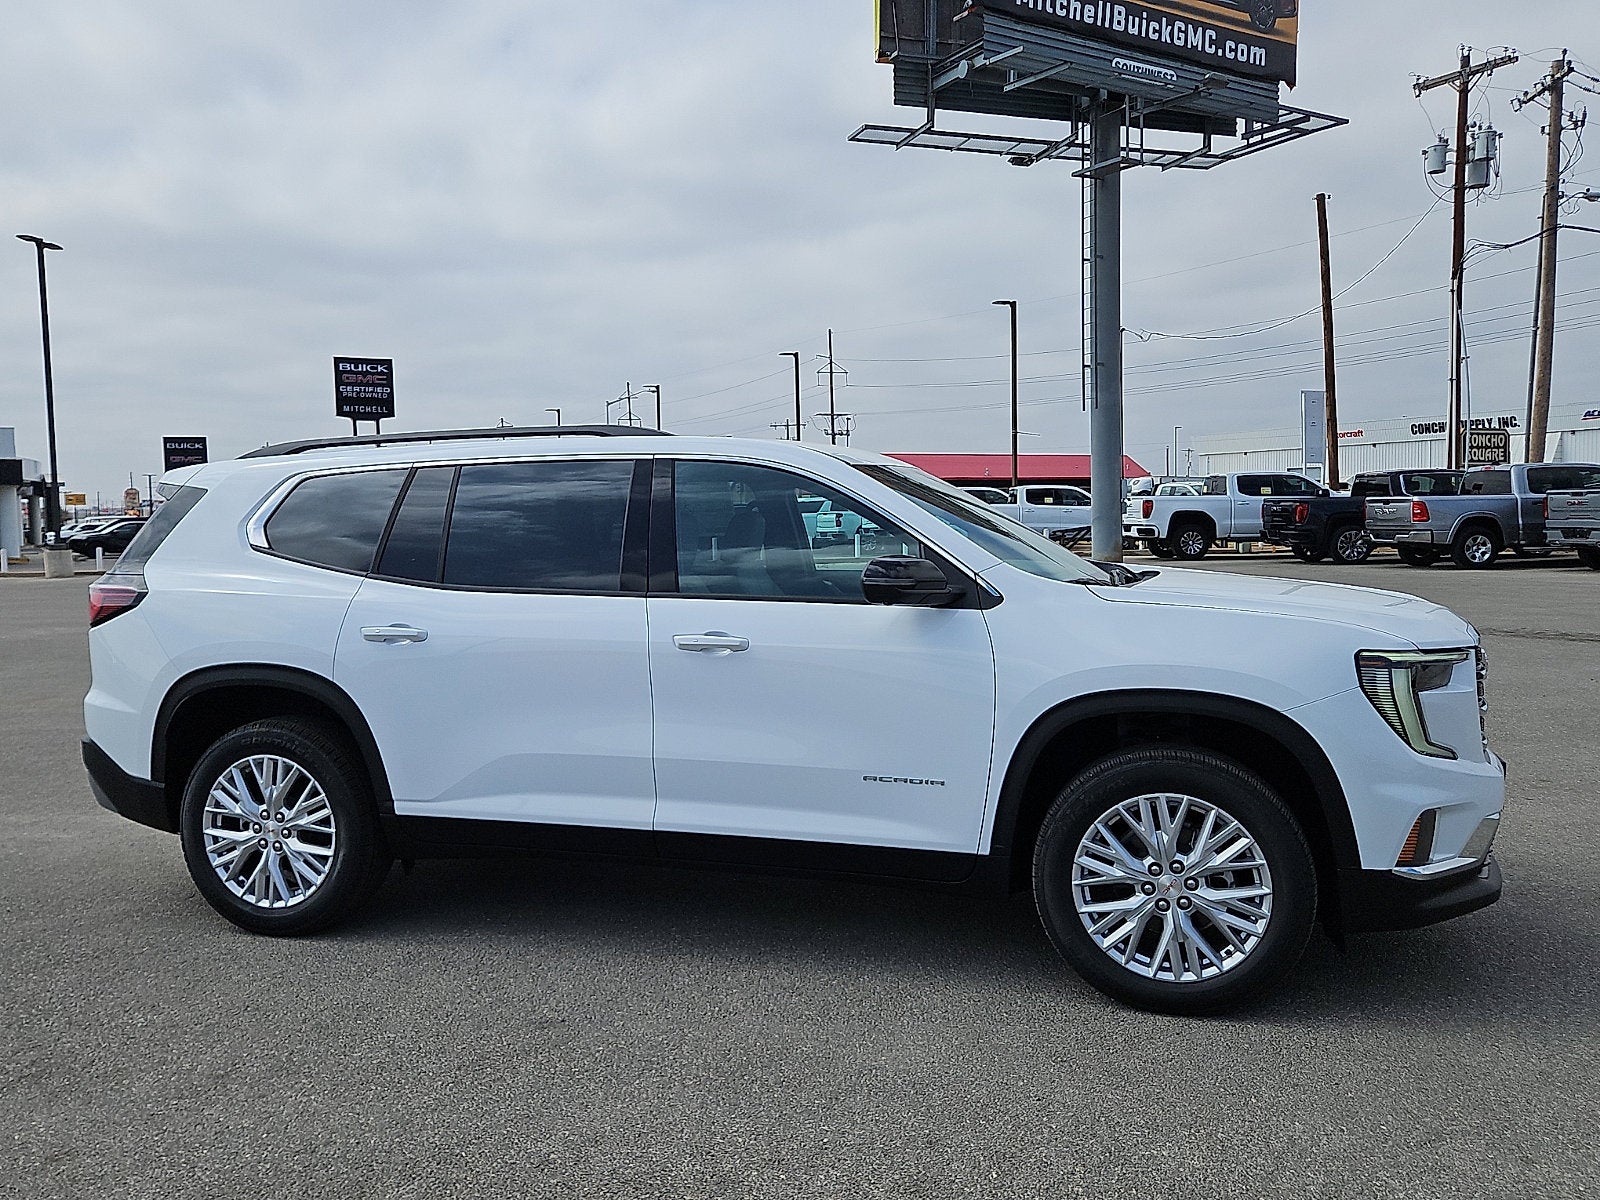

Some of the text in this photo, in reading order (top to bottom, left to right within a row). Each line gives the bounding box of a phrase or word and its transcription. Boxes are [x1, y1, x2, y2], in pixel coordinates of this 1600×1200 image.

[339, 363, 389, 373] BUICK
[342, 374, 387, 383] GMC
[339, 385, 391, 393] CERTIFIED
[343, 405, 389, 413] MITCHELL
[1411, 421, 1447, 435] CONCH
[1497, 415, 1521, 429] INC.
[862, 775, 945, 786] ACADIA
